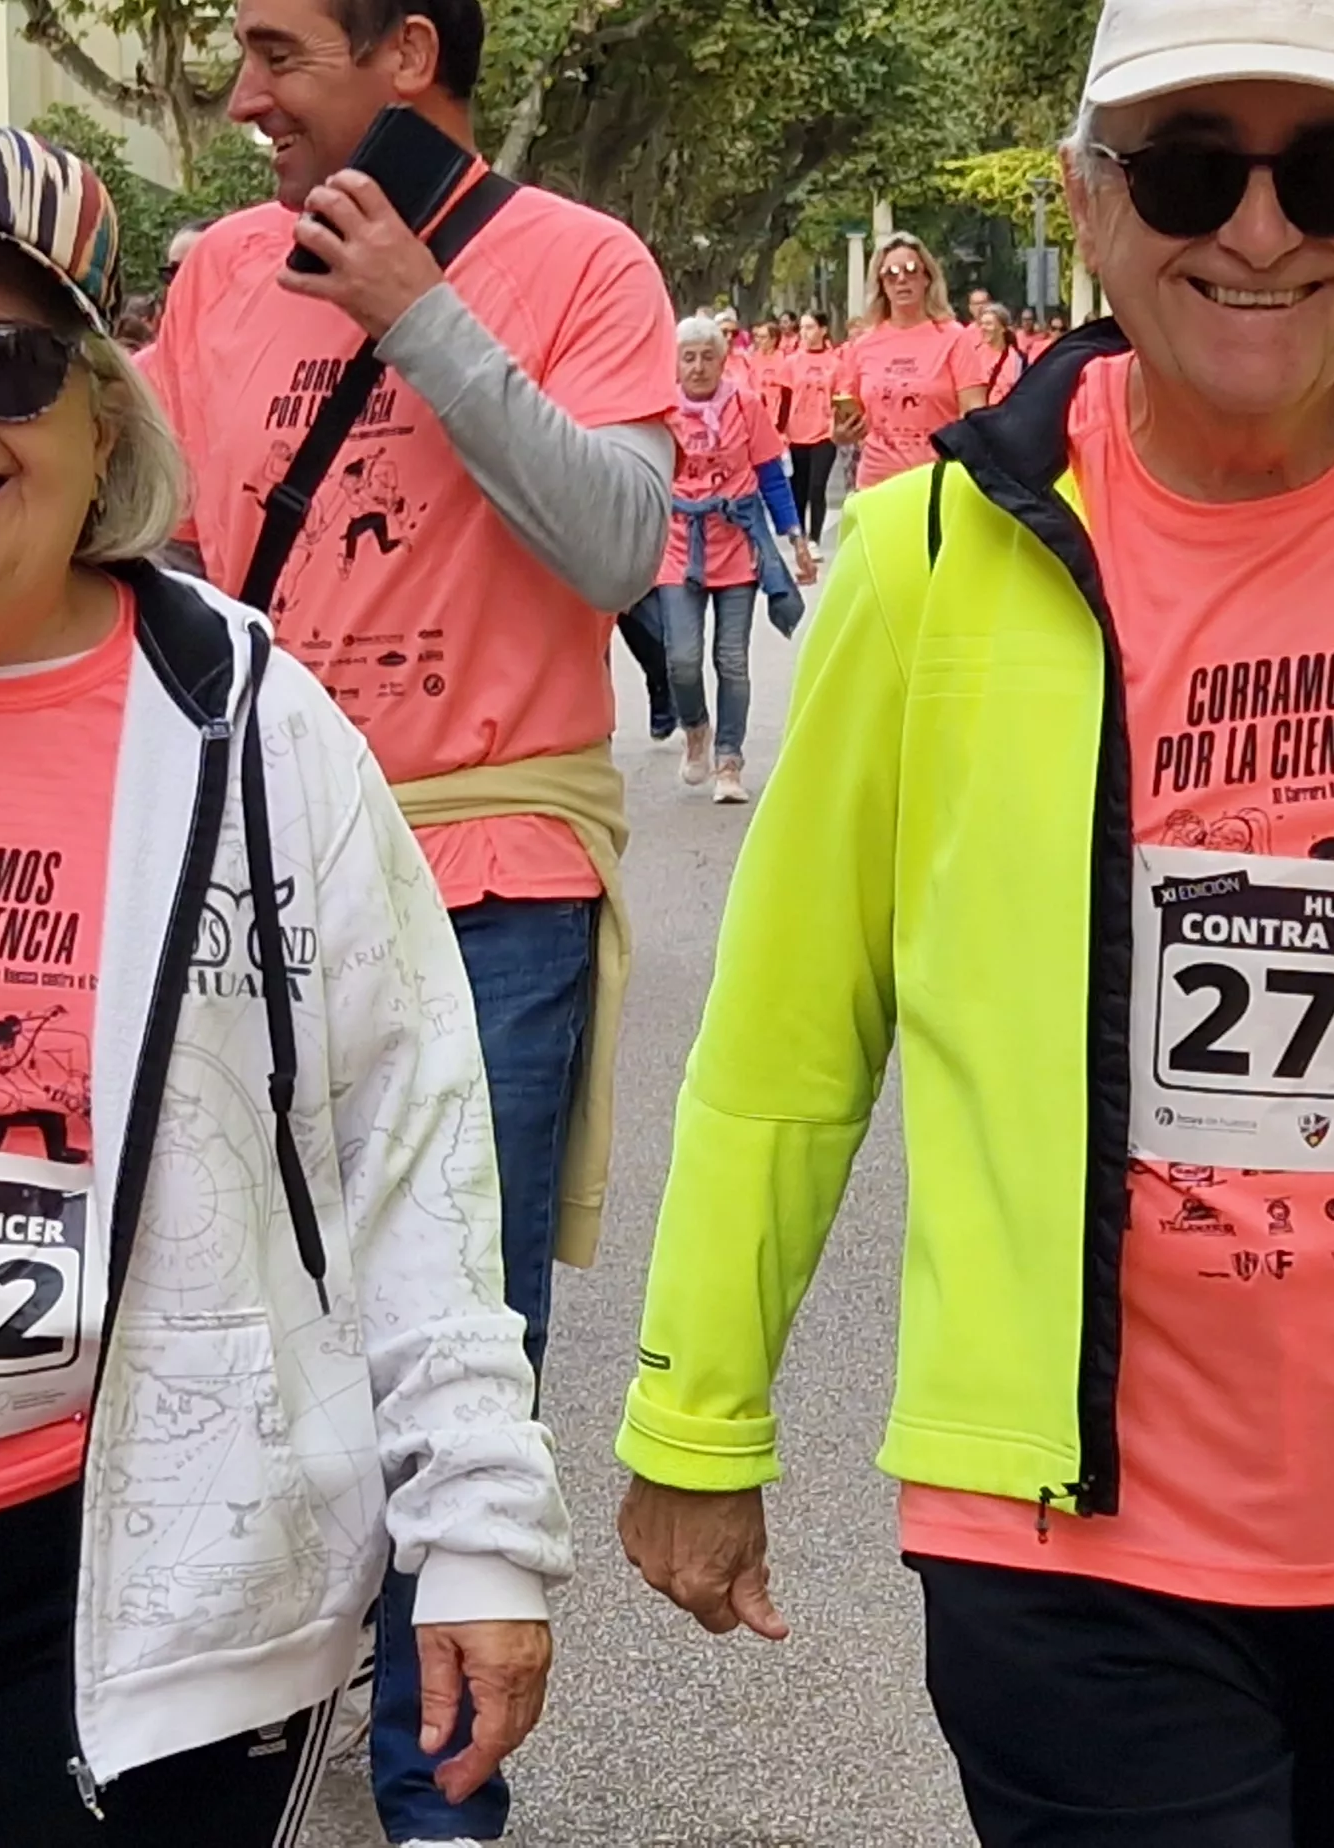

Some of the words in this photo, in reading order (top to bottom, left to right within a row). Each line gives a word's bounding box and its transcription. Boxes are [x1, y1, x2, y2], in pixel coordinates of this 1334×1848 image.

[265, 395, 303, 430] POR
[1152, 731, 1215, 797] POR
[1224, 723, 1257, 785] LA
[1160, 887, 1176, 904] XI
[1182, 912, 1329, 950] CONTRA
